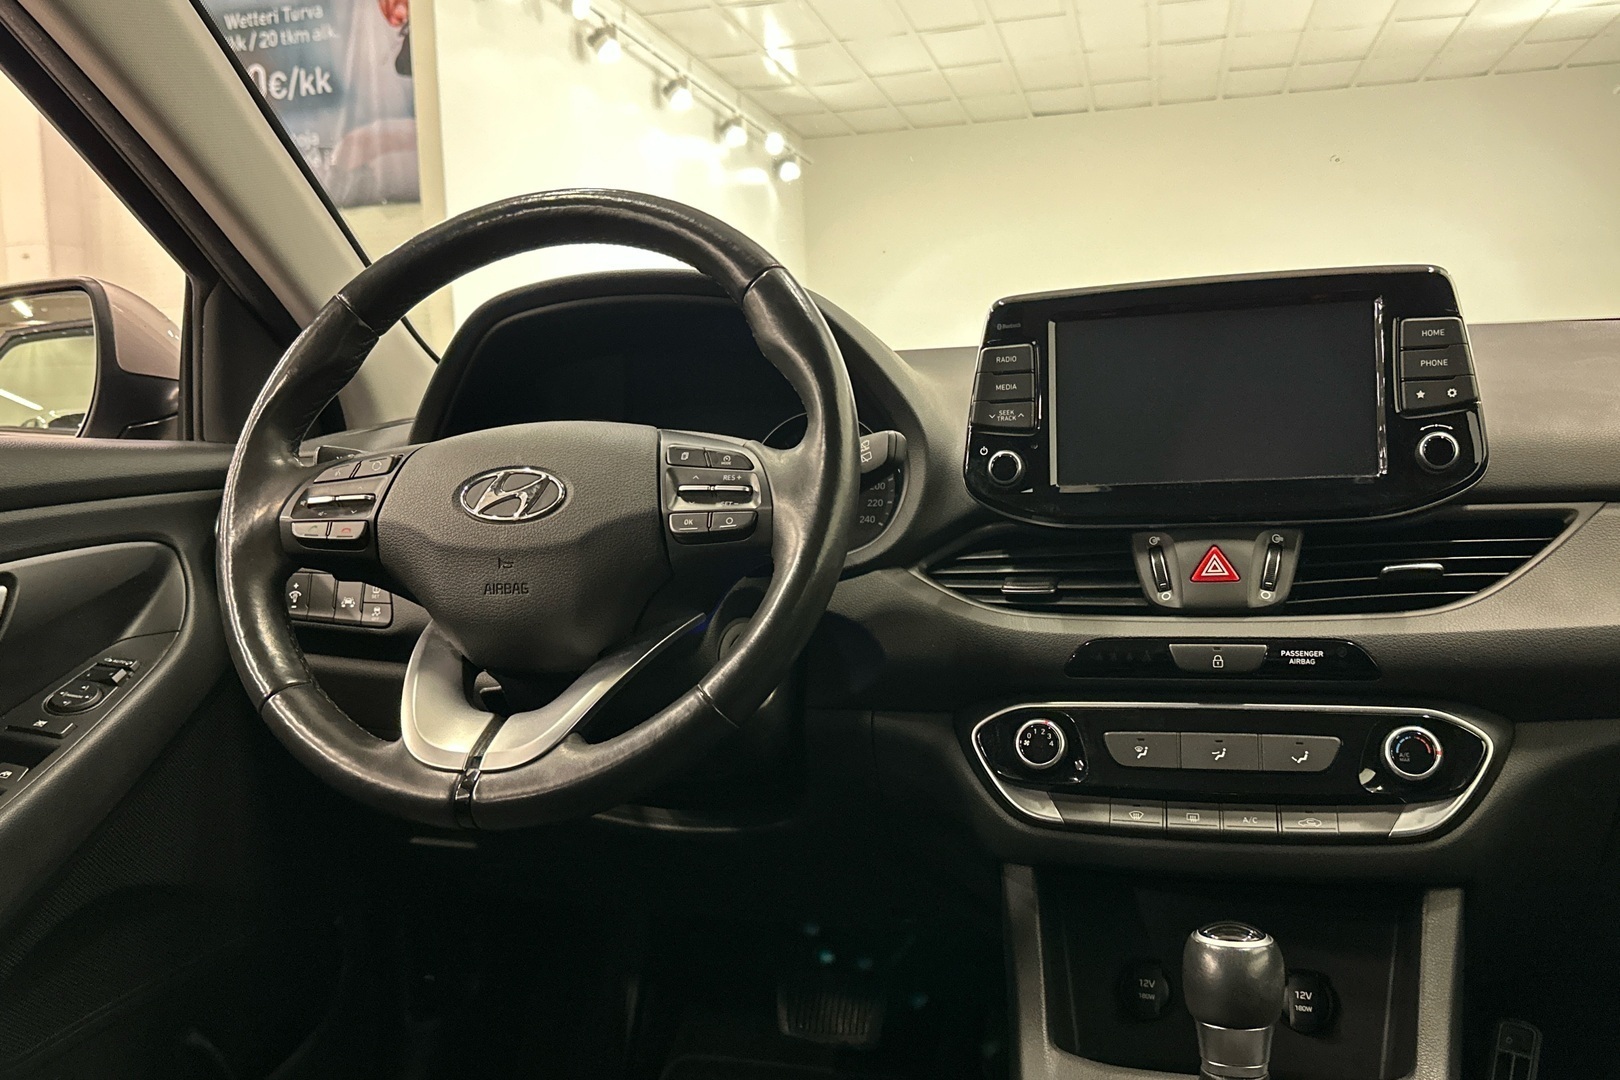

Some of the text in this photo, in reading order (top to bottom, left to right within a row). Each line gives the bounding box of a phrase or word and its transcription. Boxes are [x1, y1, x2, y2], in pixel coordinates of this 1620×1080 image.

[223, 4, 325, 31] Wetteri Turva
[258, 28, 278, 49] 20
[1421, 328, 1445, 337] HOME
[995, 355, 1017, 363] RADIO
[1420, 358, 1449, 367] PHONE
[995, 383, 1017, 391] MEDIA
[867, 498, 884, 508] 220
[683, 518, 694, 526] OK
[859, 515, 876, 524] 240
[484, 582, 529, 595] AIRBAG
[1280, 650, 1324, 658] PASSENGER
[1242, 816, 1258, 824] A/C
[1139, 978, 1156, 988] 12V
[1294, 990, 1313, 1000] 12V
